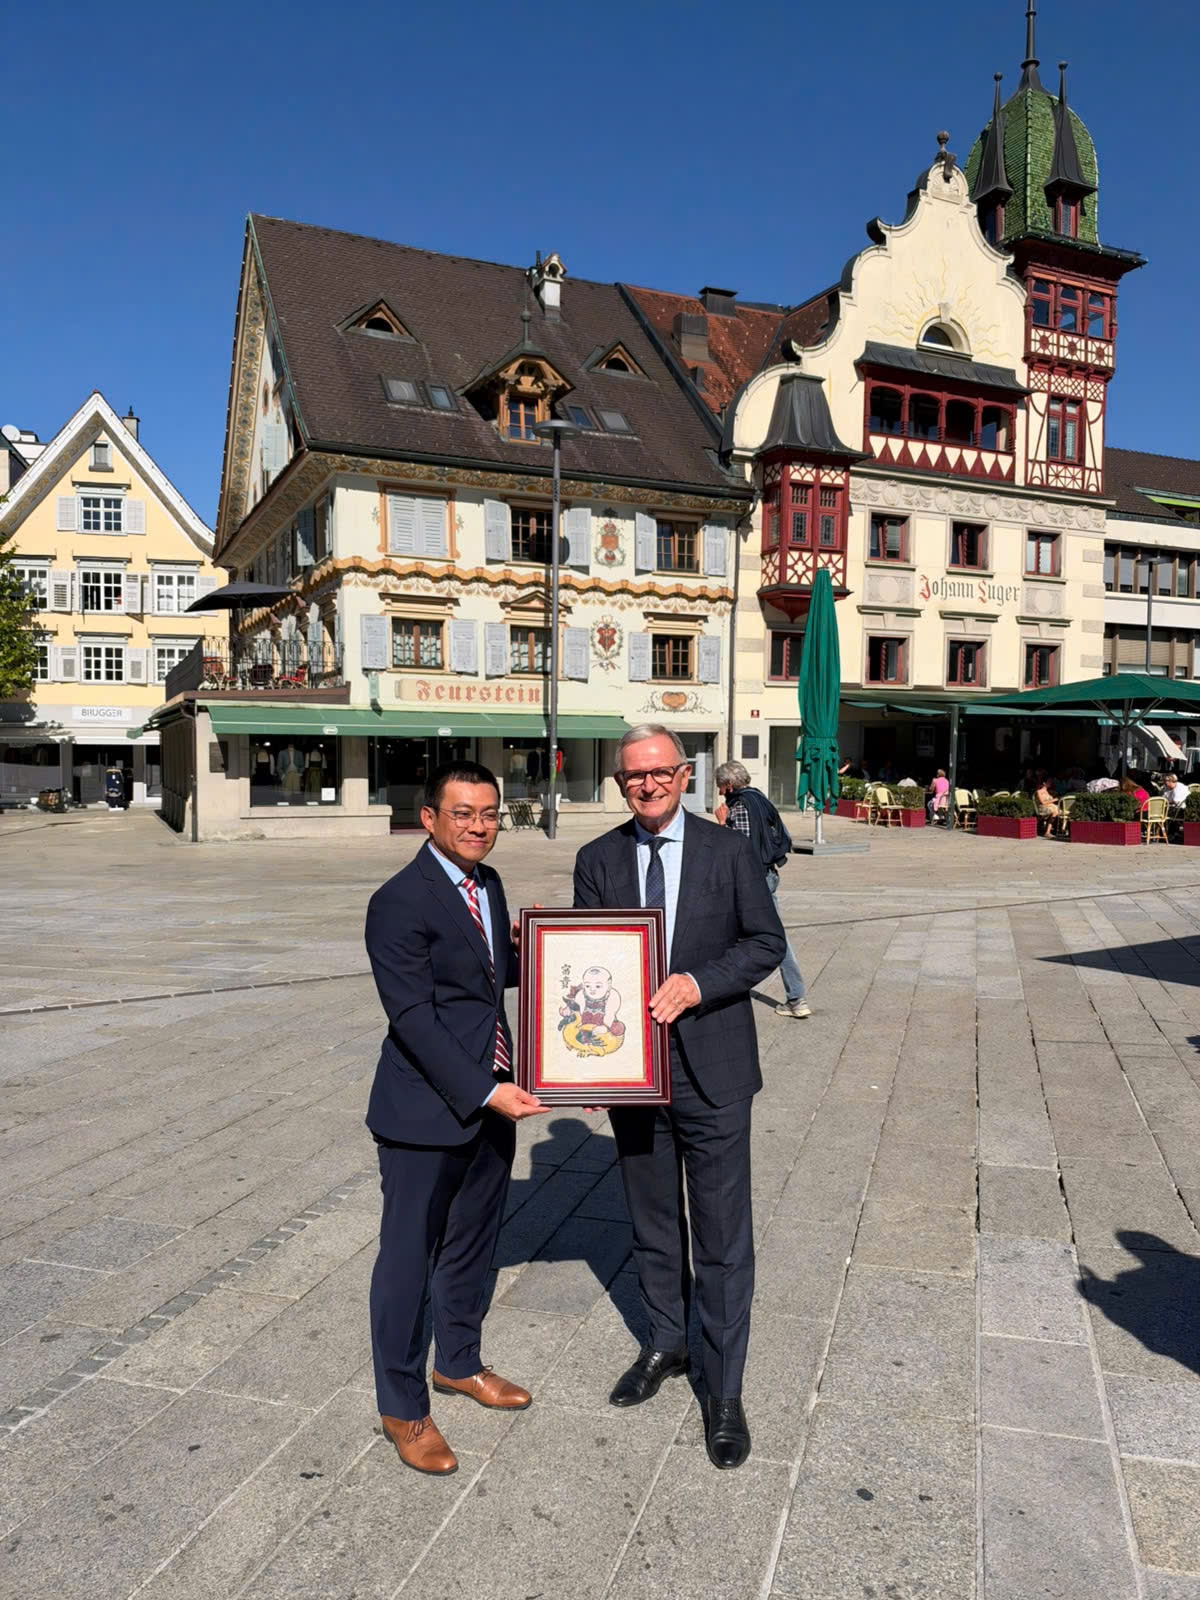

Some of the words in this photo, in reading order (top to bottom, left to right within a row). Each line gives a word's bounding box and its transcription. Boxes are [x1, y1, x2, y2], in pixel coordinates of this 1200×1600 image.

[920, 574, 974, 601] Johann
[416, 679, 541, 703] Feurstein
[81, 708, 122, 717] BRUGGER
